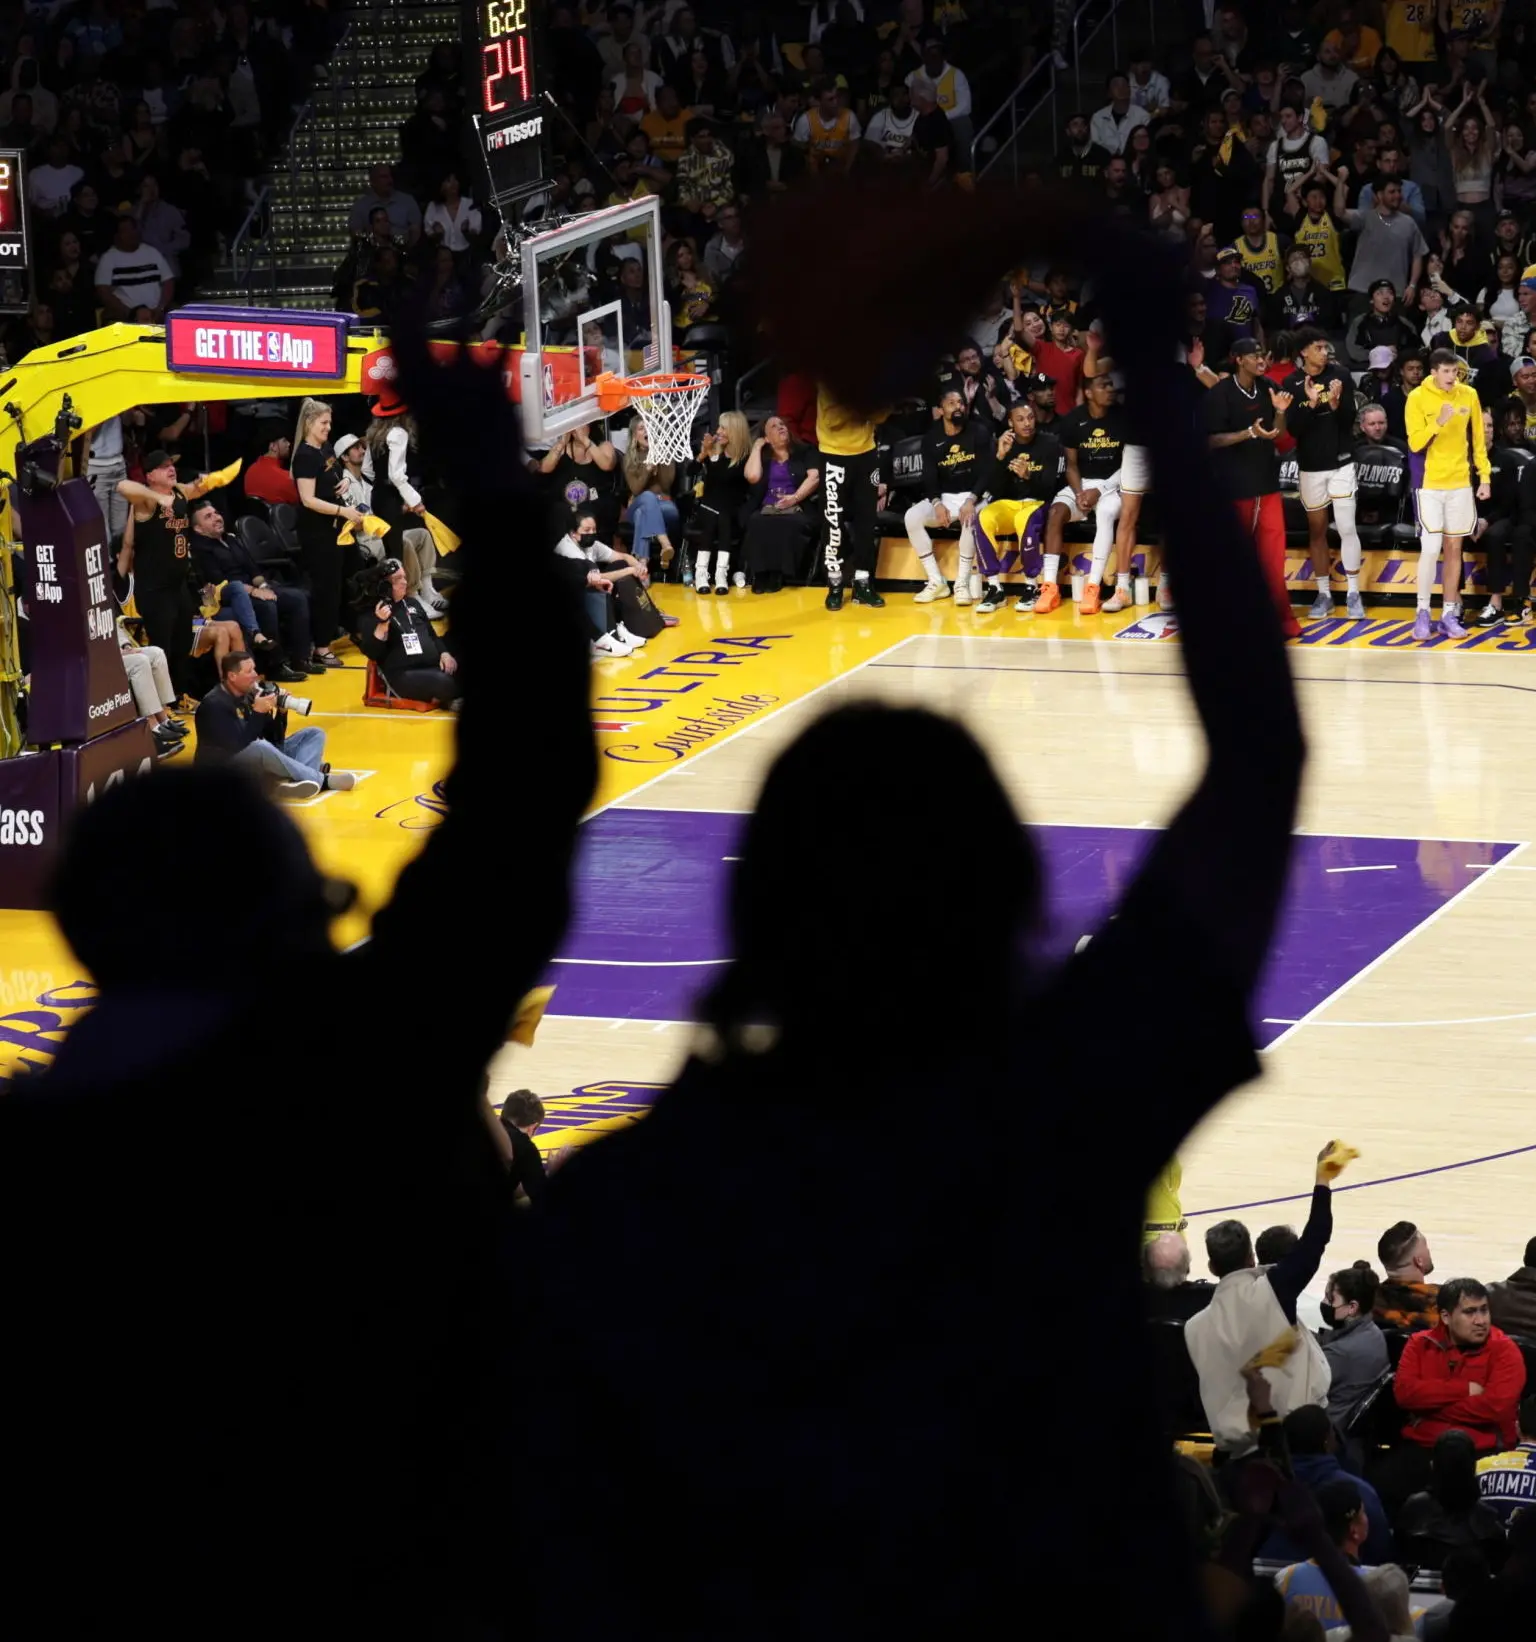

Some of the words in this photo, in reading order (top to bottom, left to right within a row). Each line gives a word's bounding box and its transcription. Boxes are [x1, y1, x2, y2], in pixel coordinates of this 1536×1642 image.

[487, 0, 527, 37] 6:22
[483, 36, 528, 112] 24
[504, 117, 543, 145] TISSOT
[195, 327, 228, 359] GET
[230, 331, 264, 361] THE
[281, 333, 313, 369] App
[1357, 464, 1404, 484] PLAYOFFS
[824, 461, 845, 573] Readymade
[36, 545, 54, 563] GET
[85, 544, 103, 576] GET
[37, 564, 57, 582] THE
[45, 585, 62, 603] App
[88, 574, 107, 605] THE
[95, 607, 114, 640] App
[589, 634, 794, 713] ULTRA
[88, 698, 115, 719] Google
[114, 689, 132, 708] Pixel
[603, 694, 780, 763] Courtside
[0, 808, 44, 845] ass
